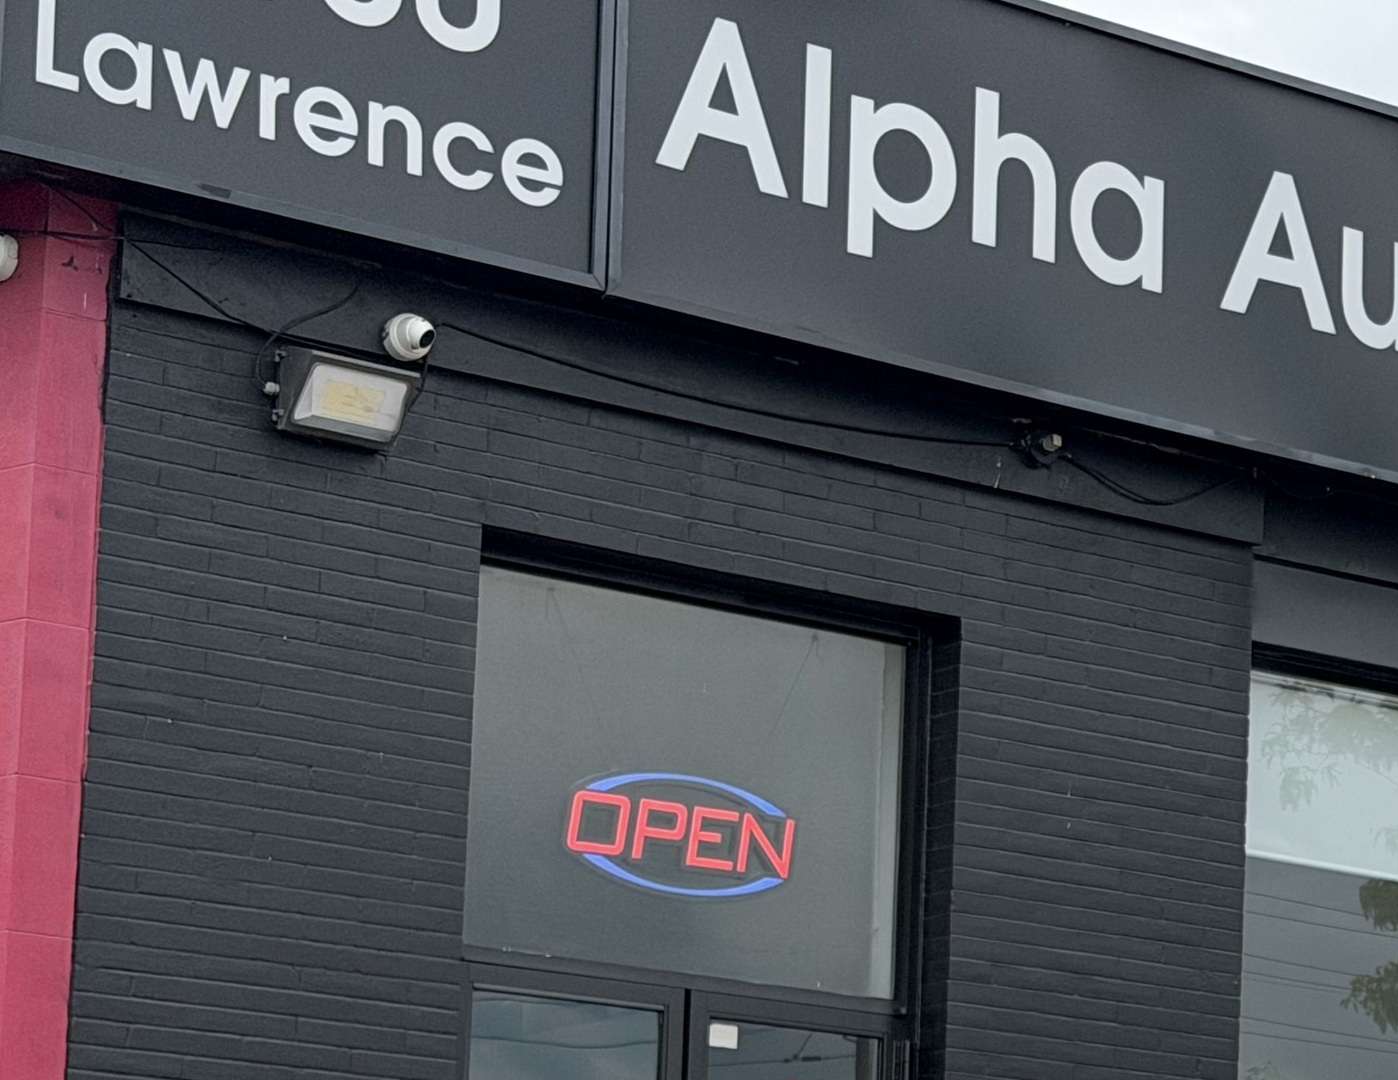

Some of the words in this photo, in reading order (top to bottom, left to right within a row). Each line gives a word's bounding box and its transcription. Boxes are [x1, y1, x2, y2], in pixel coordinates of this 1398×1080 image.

[35, 0, 565, 207] Lawrence
[655, 17, 1166, 294] Alpha
[566, 790, 796, 880] OPEN
